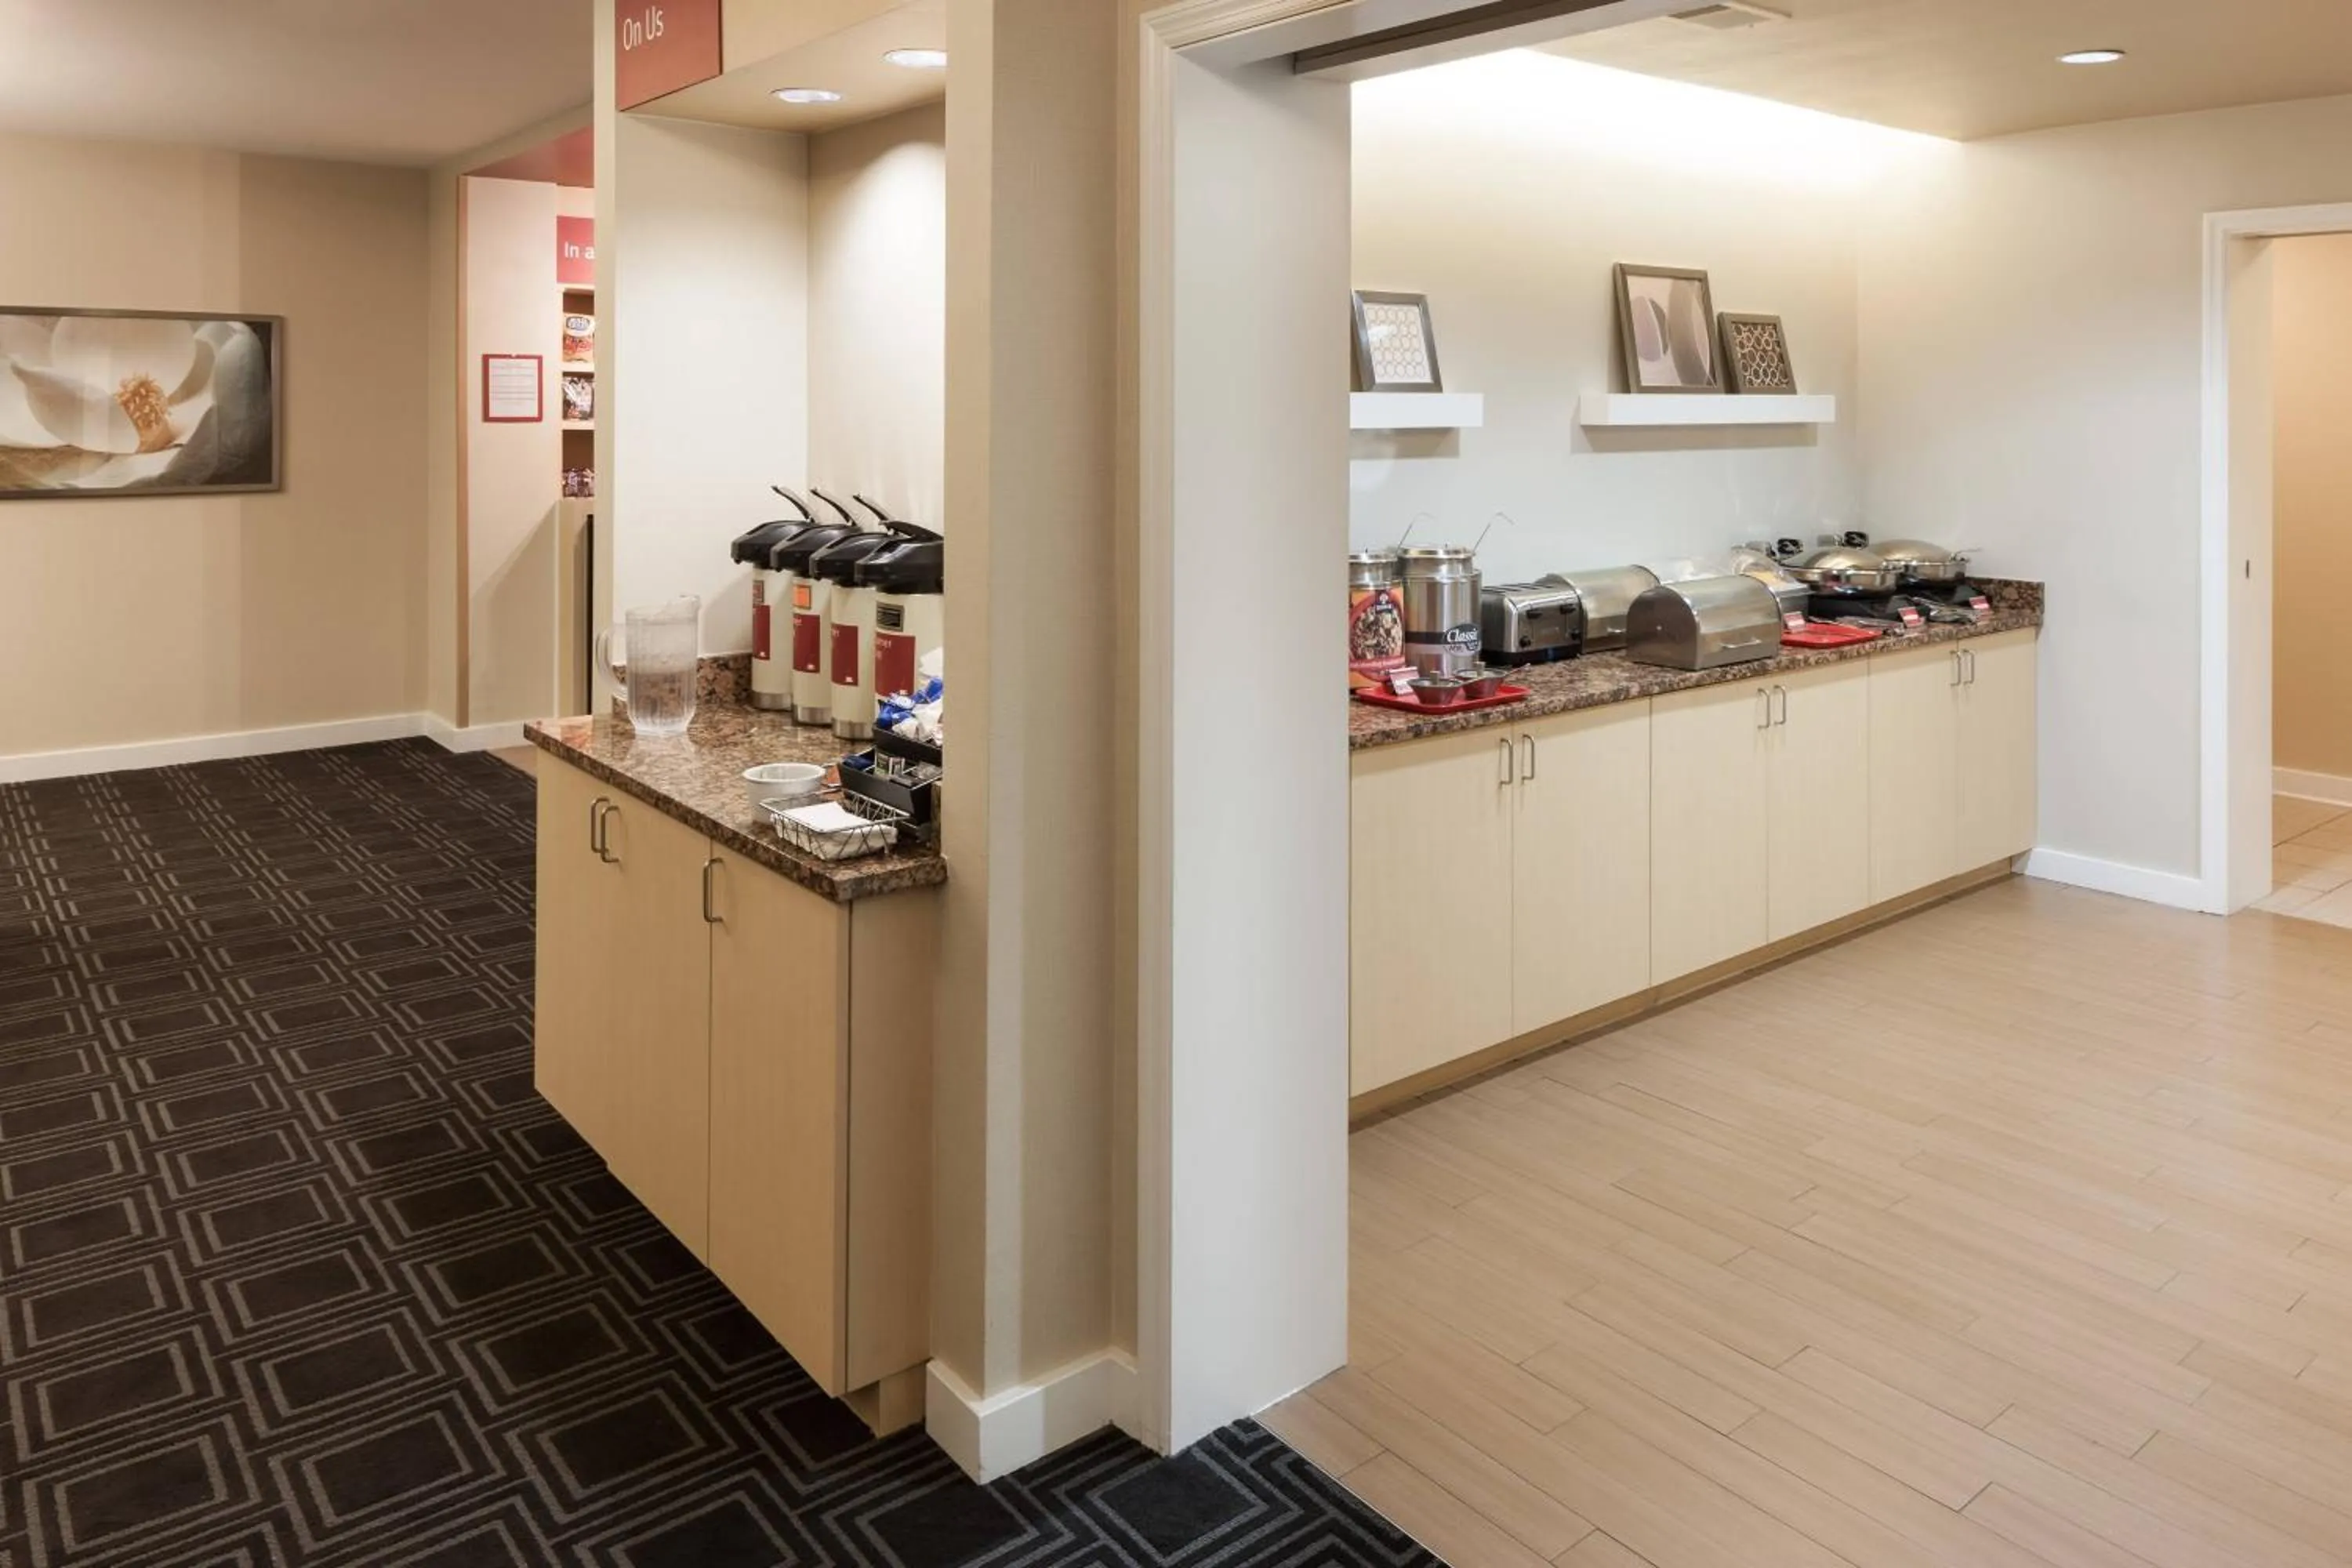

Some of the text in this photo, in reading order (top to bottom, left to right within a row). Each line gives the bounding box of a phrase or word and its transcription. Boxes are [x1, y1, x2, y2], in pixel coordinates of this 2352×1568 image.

[623, 5, 664, 50] On Us
[564, 241, 580, 259] In
